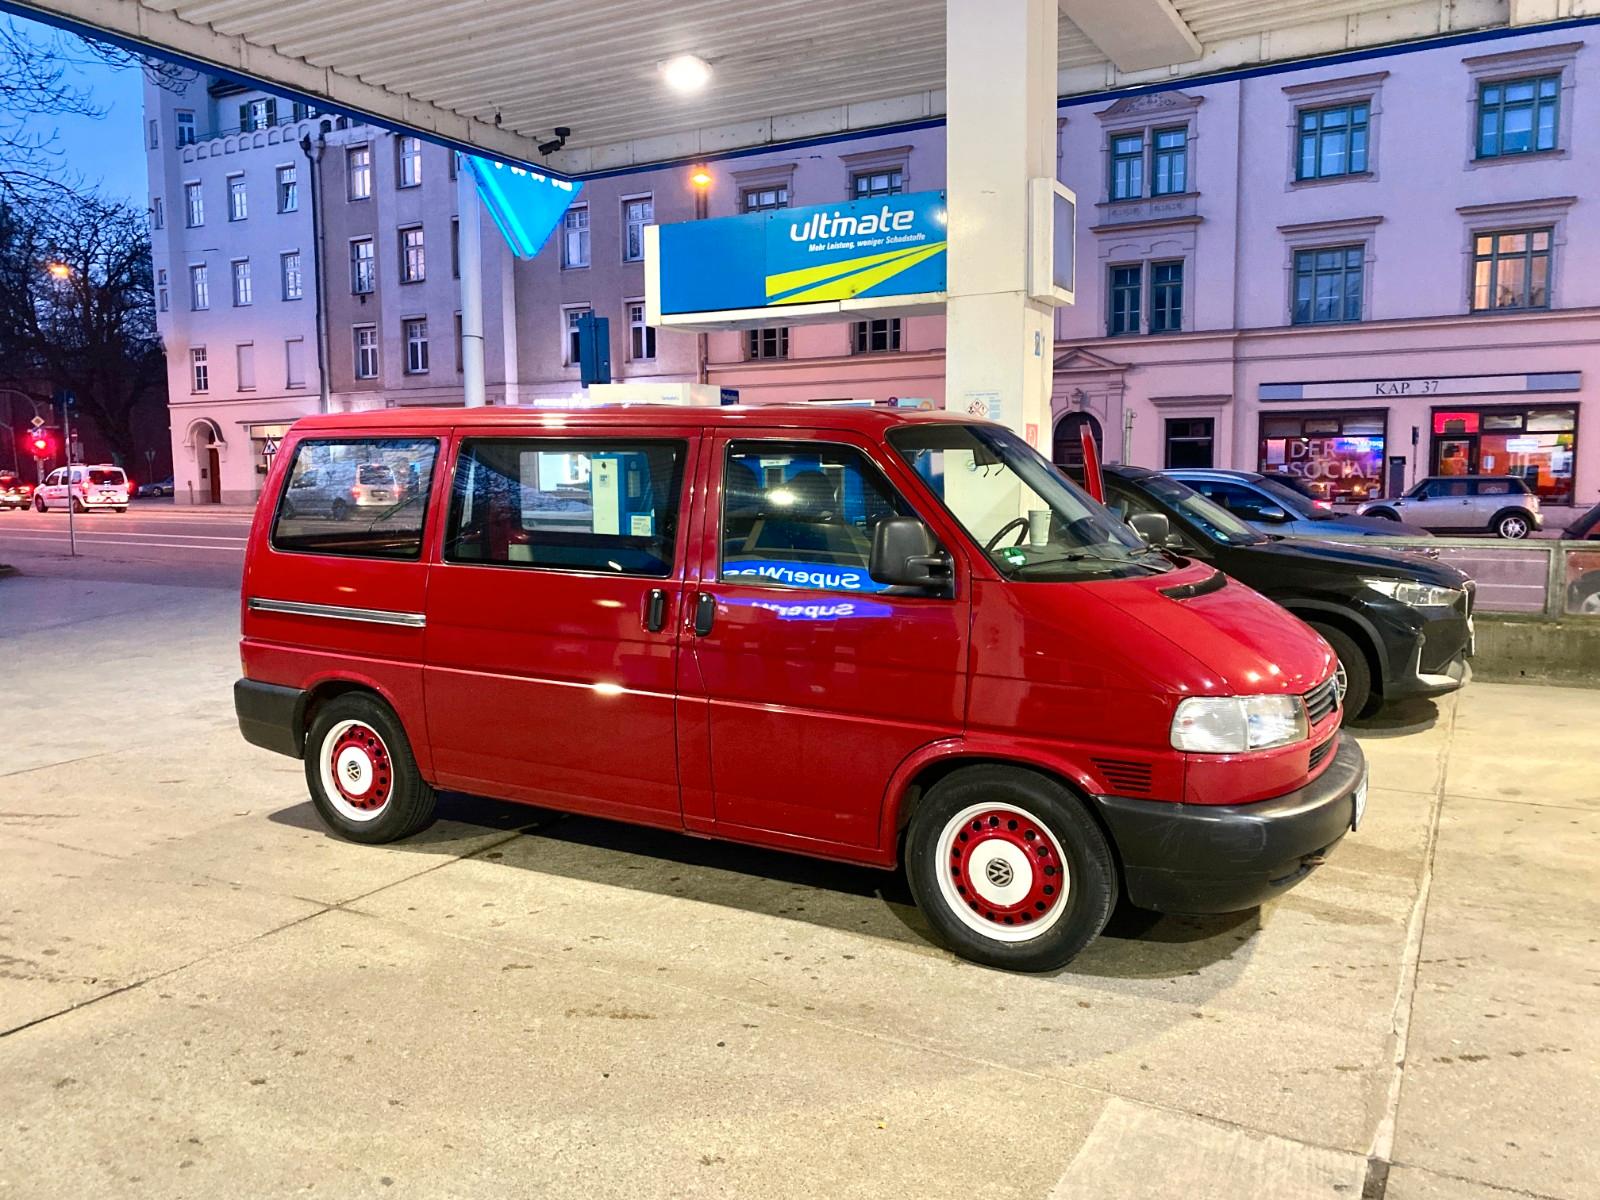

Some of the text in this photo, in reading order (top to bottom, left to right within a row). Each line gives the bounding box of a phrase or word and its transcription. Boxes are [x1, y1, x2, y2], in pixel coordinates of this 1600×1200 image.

[790, 205, 914, 242] ultimate
[808, 232, 926, 252] Mehr Leistung, weniger Schadstoffe
[1375, 380, 1439, 395] KAP 37
[1291, 441, 1336, 458] DER
[1291, 460, 1380, 479] SOCIAL
